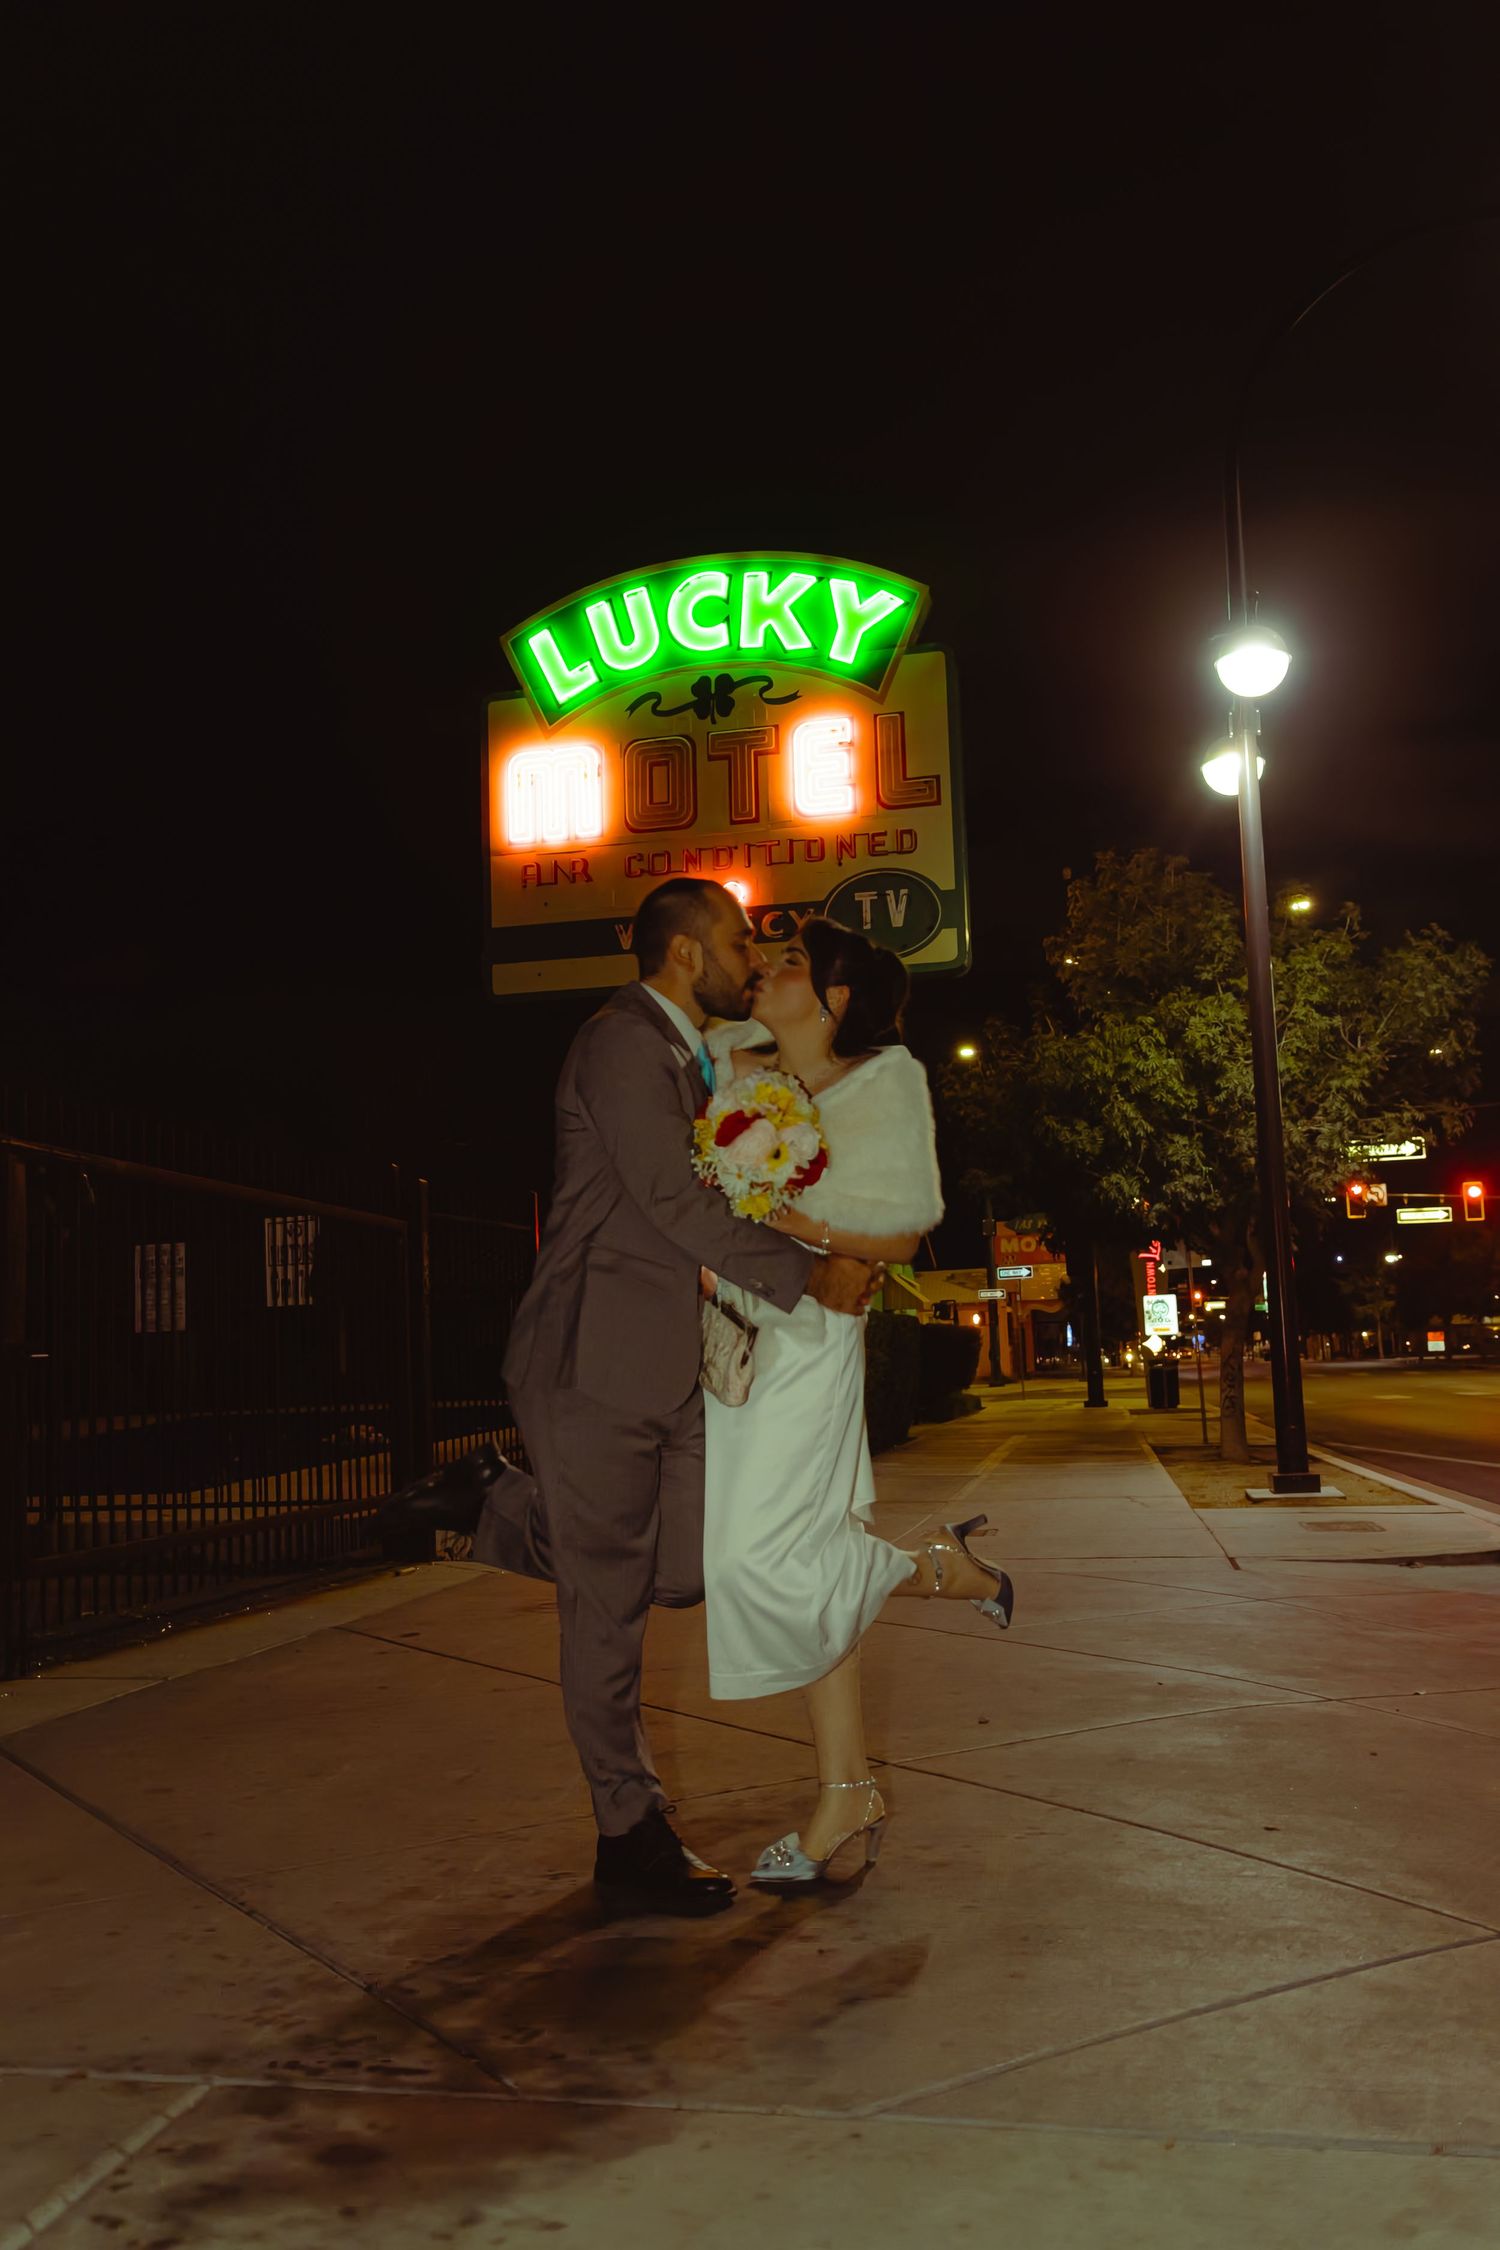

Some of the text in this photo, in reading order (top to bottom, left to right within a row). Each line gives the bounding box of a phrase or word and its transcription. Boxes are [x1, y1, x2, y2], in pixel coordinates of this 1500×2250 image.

[528, 570, 905, 705] LUCKY
[507, 711, 942, 846] MOTEL
[520, 828, 918, 888] AIR CONDITIONED
[853, 888, 911, 930] TV
